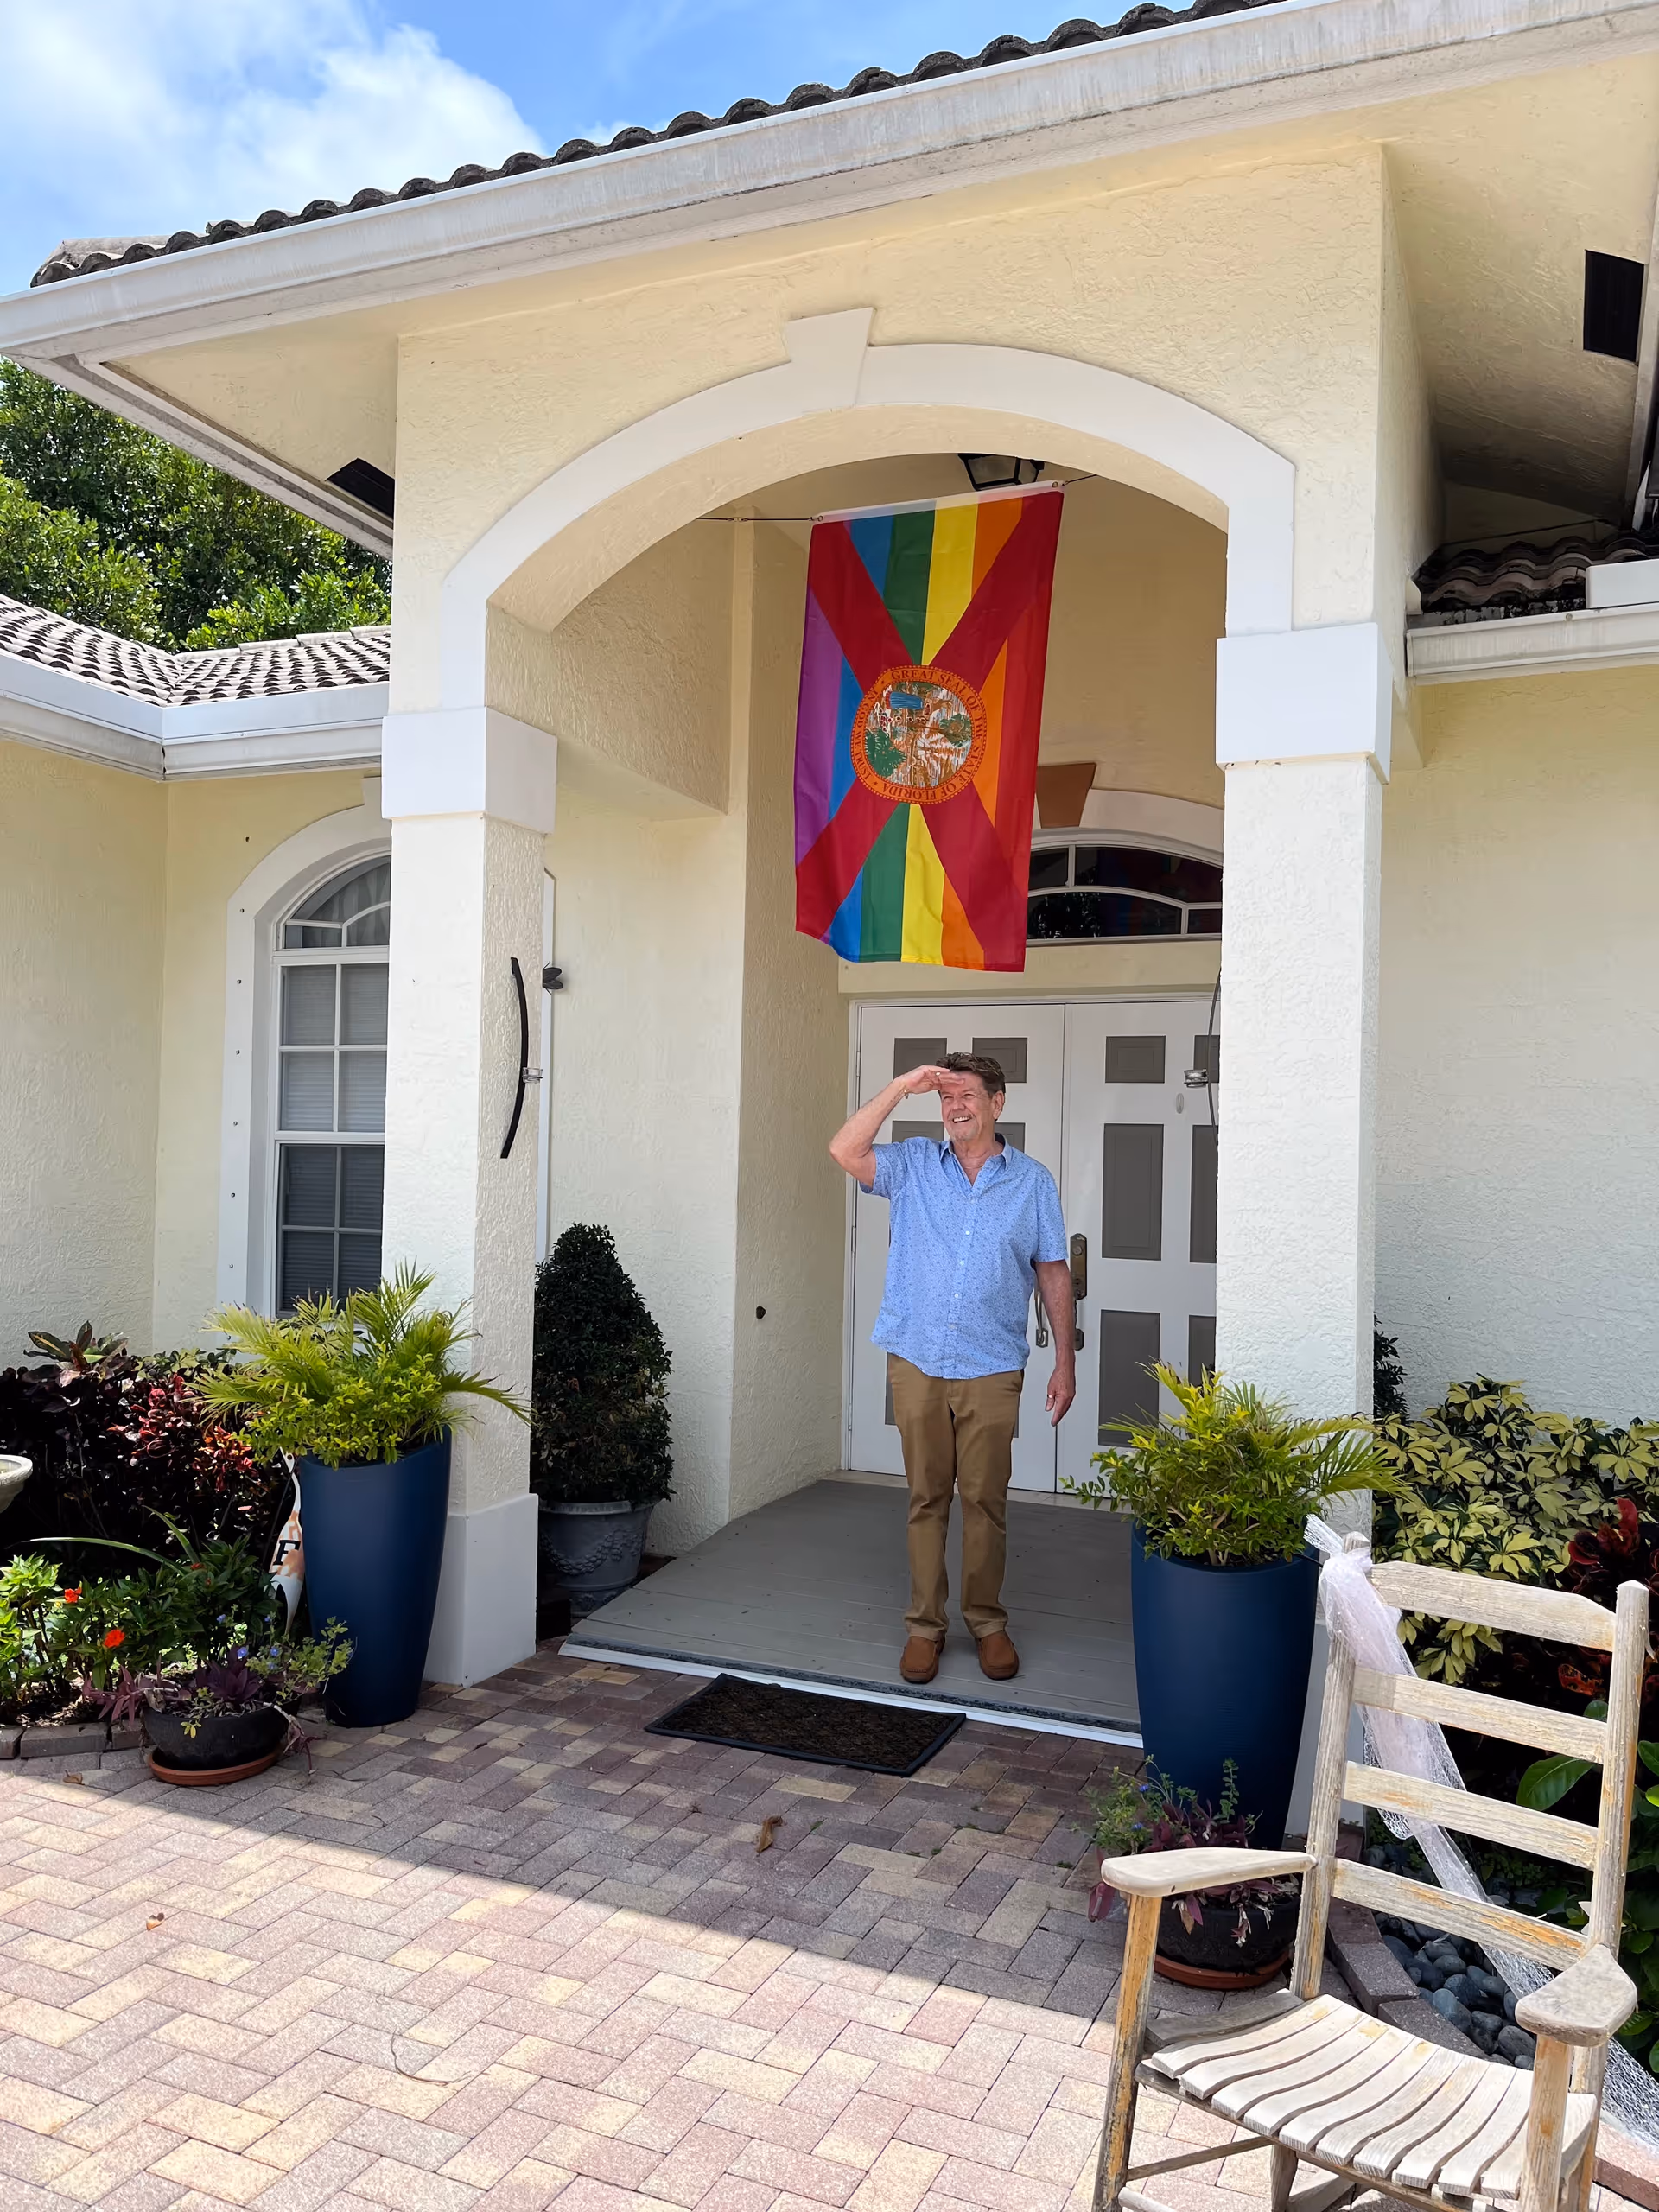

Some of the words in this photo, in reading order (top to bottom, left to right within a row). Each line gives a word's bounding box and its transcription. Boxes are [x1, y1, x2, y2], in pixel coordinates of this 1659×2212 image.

[891, 670, 936, 680] GREAT
[938, 672, 966, 697] SEAL
[868, 690, 879, 702] IN
[966, 696, 979, 711] OF
[857, 702, 869, 728] GOD
[974, 715, 983, 741] THE
[854, 729, 861, 750] WE
[855, 750, 870, 781] TRUST
[958, 746, 982, 784] STATE
[882, 783, 937, 800] FLORIDA
[941, 783, 957, 798] OF
